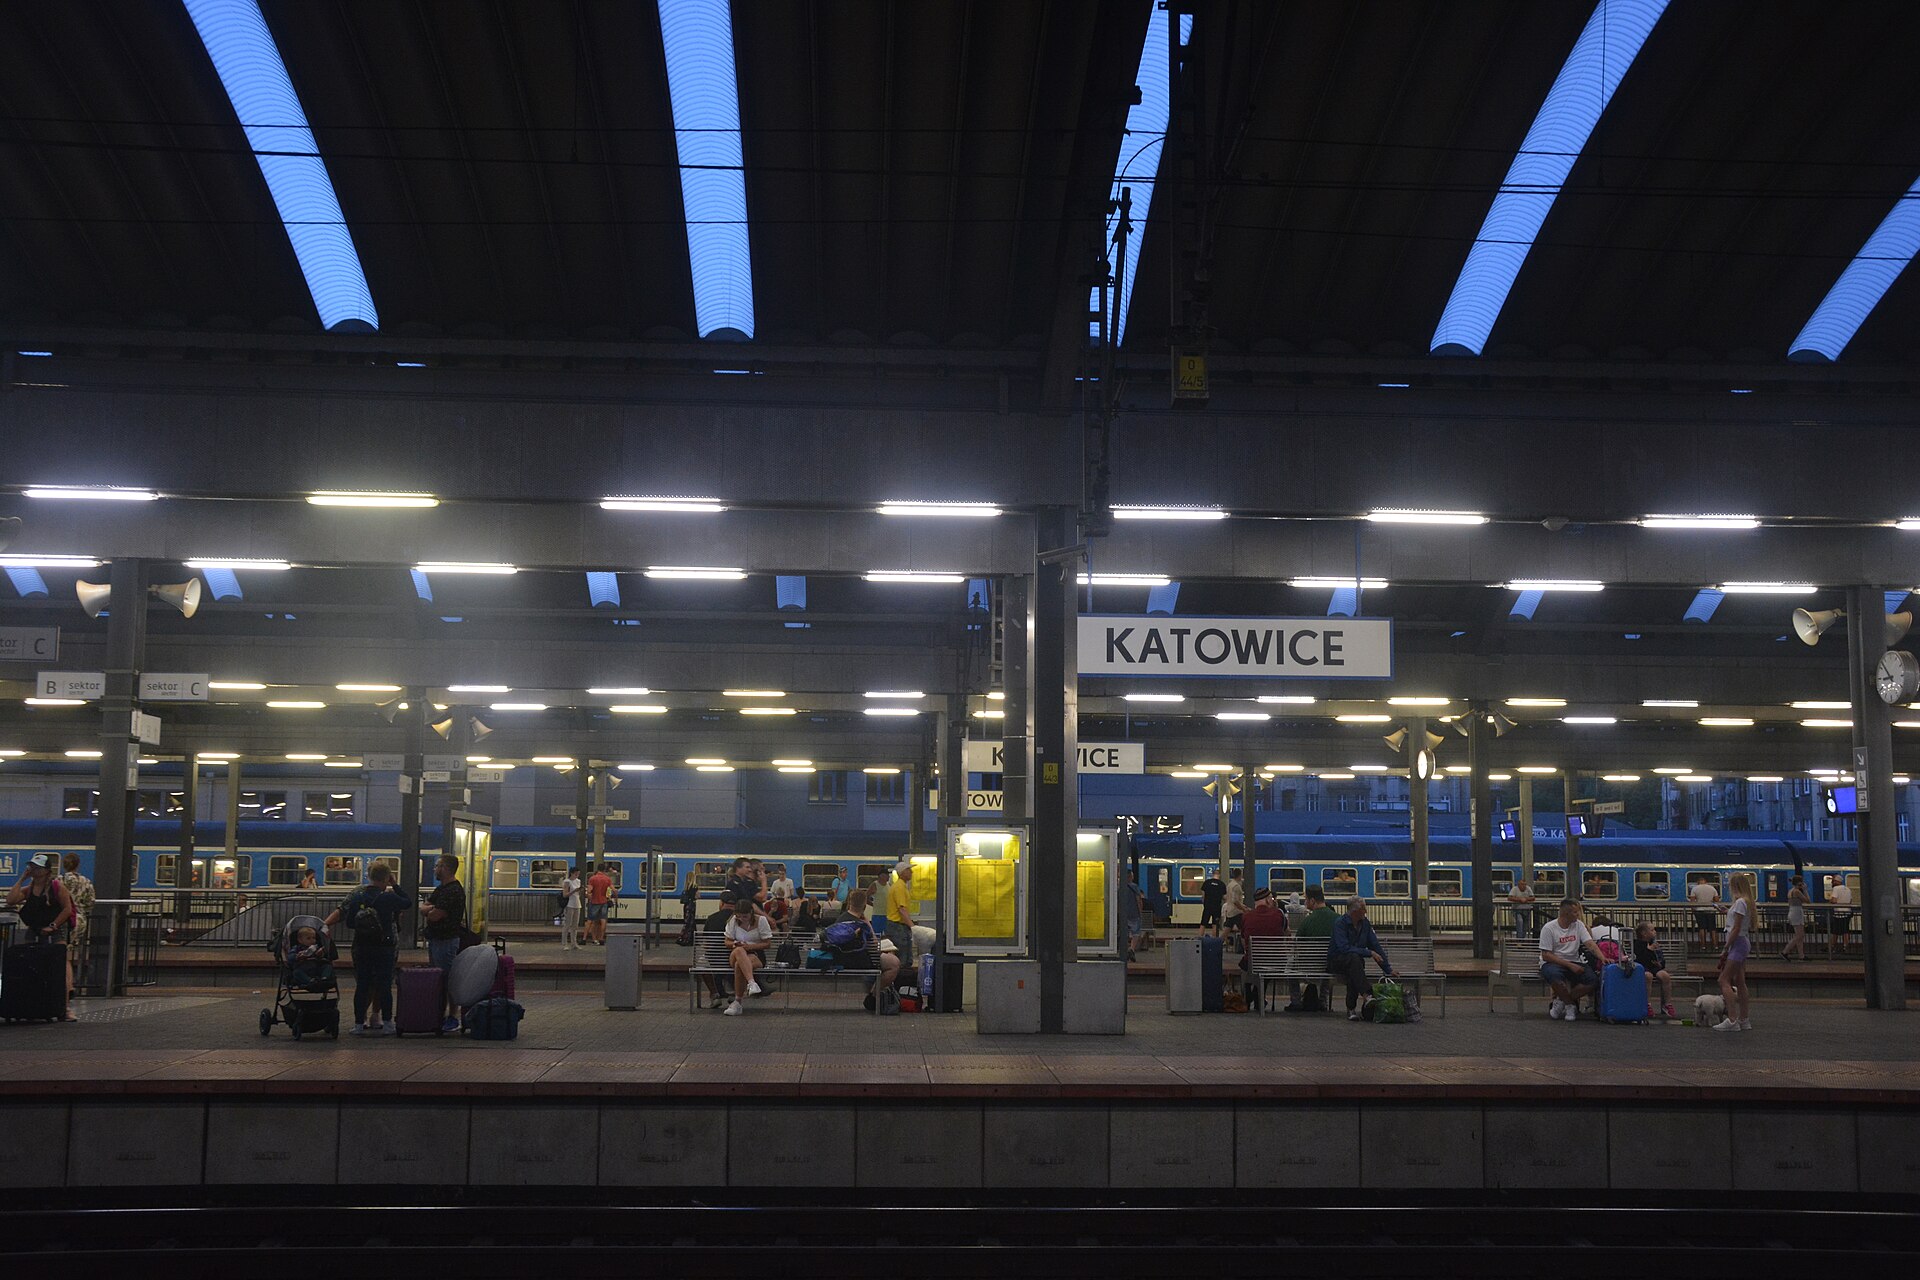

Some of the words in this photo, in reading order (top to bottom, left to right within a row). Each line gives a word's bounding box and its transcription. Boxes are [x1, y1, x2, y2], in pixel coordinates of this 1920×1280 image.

[34, 638, 46, 655] C
[1106, 627, 1345, 666] KATOWICE
[46, 680, 57, 695] B
[68, 681, 101, 690] sektor
[146, 681, 179, 691] sektor
[190, 682, 201, 696] C
